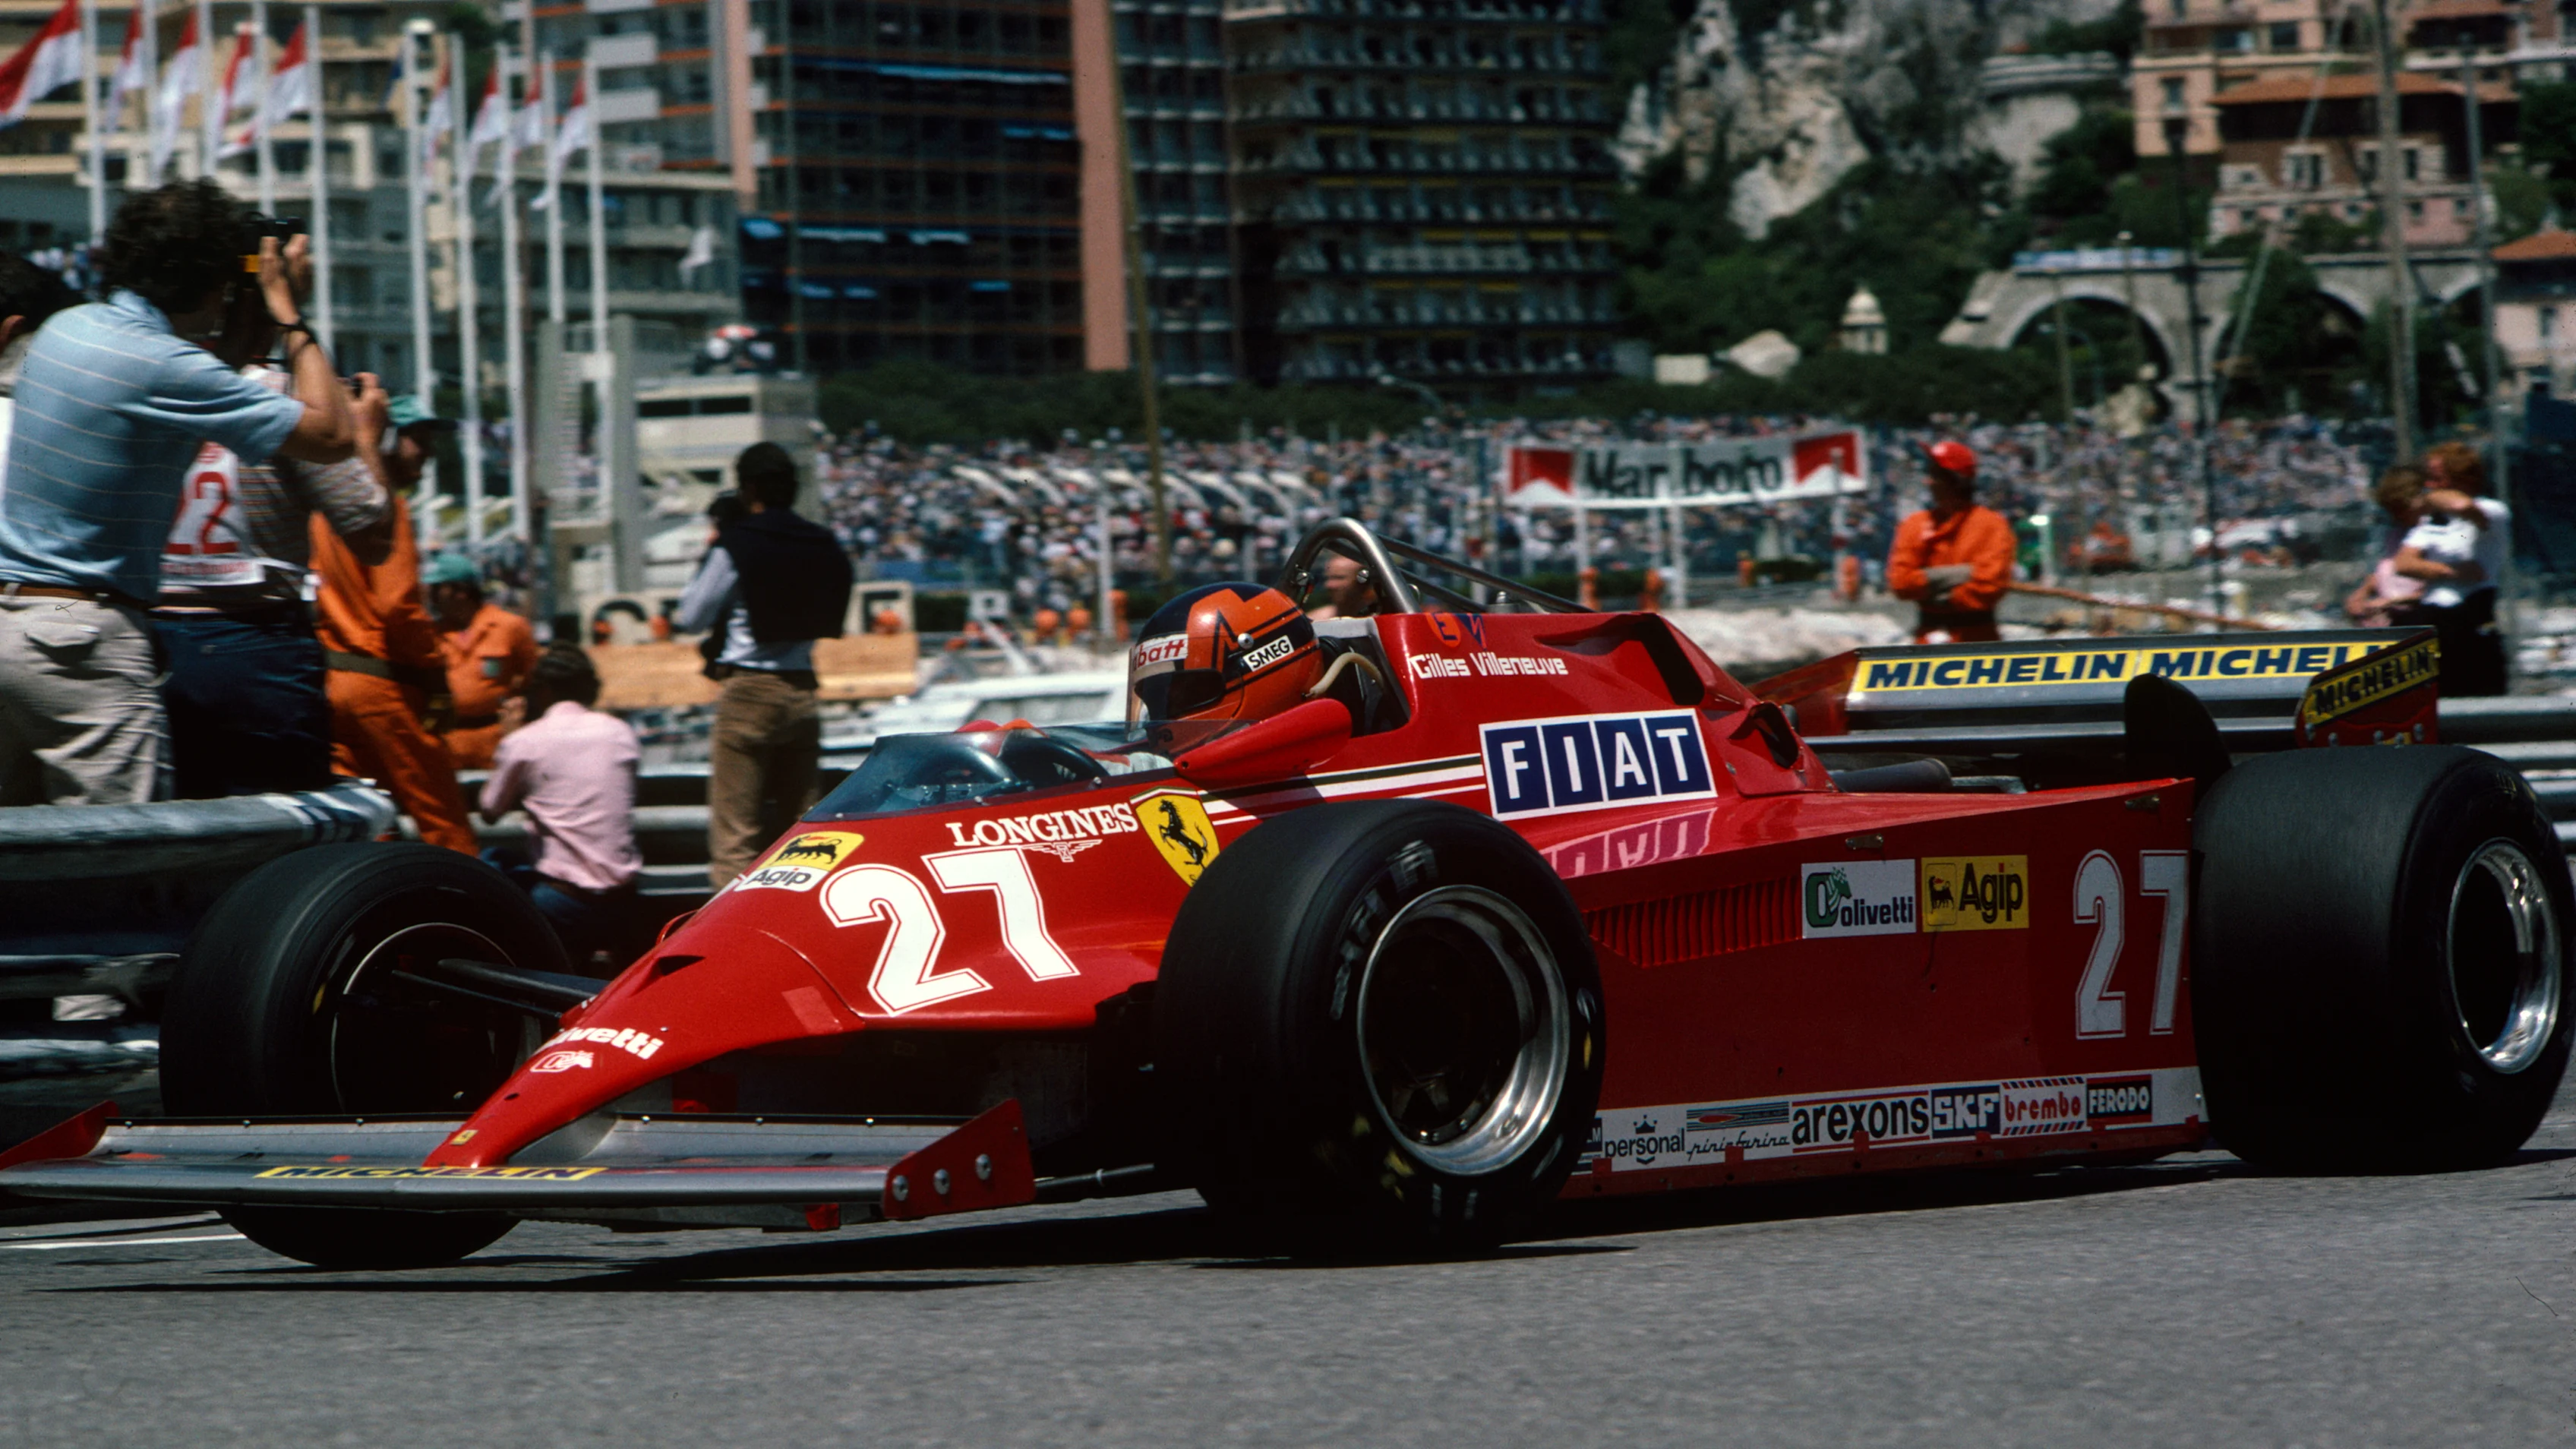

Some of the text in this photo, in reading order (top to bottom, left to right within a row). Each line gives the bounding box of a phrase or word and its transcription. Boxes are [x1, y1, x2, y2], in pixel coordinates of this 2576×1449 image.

[1584, 448, 1782, 499] Marboro
[1249, 639, 1291, 668] SMEG
[1410, 652, 1569, 679] Gilles Villeneuve
[1867, 654, 2126, 688] MICHELIN
[2148, 644, 2386, 680] MICHEL
[2314, 646, 2429, 715] MICHELIN
[1501, 728, 1689, 800] FIAT
[945, 803, 1138, 846] LONGINES
[746, 867, 812, 886] Agip
[1959, 862, 2024, 923] Agip
[1841, 896, 1914, 927] olivetti
[819, 847, 1081, 1017] 27
[2073, 849, 2189, 1040] 27
[1933, 1091, 2000, 1131] SKF
[2003, 1091, 2082, 1122] brembo
[2088, 1086, 2149, 1114] FERODO
[1792, 1096, 1930, 1145] arexons
[1605, 1127, 1685, 1159] personal
[1687, 1130, 1790, 1161] pinifarina
[266, 1166, 586, 1180] MICHELIN
